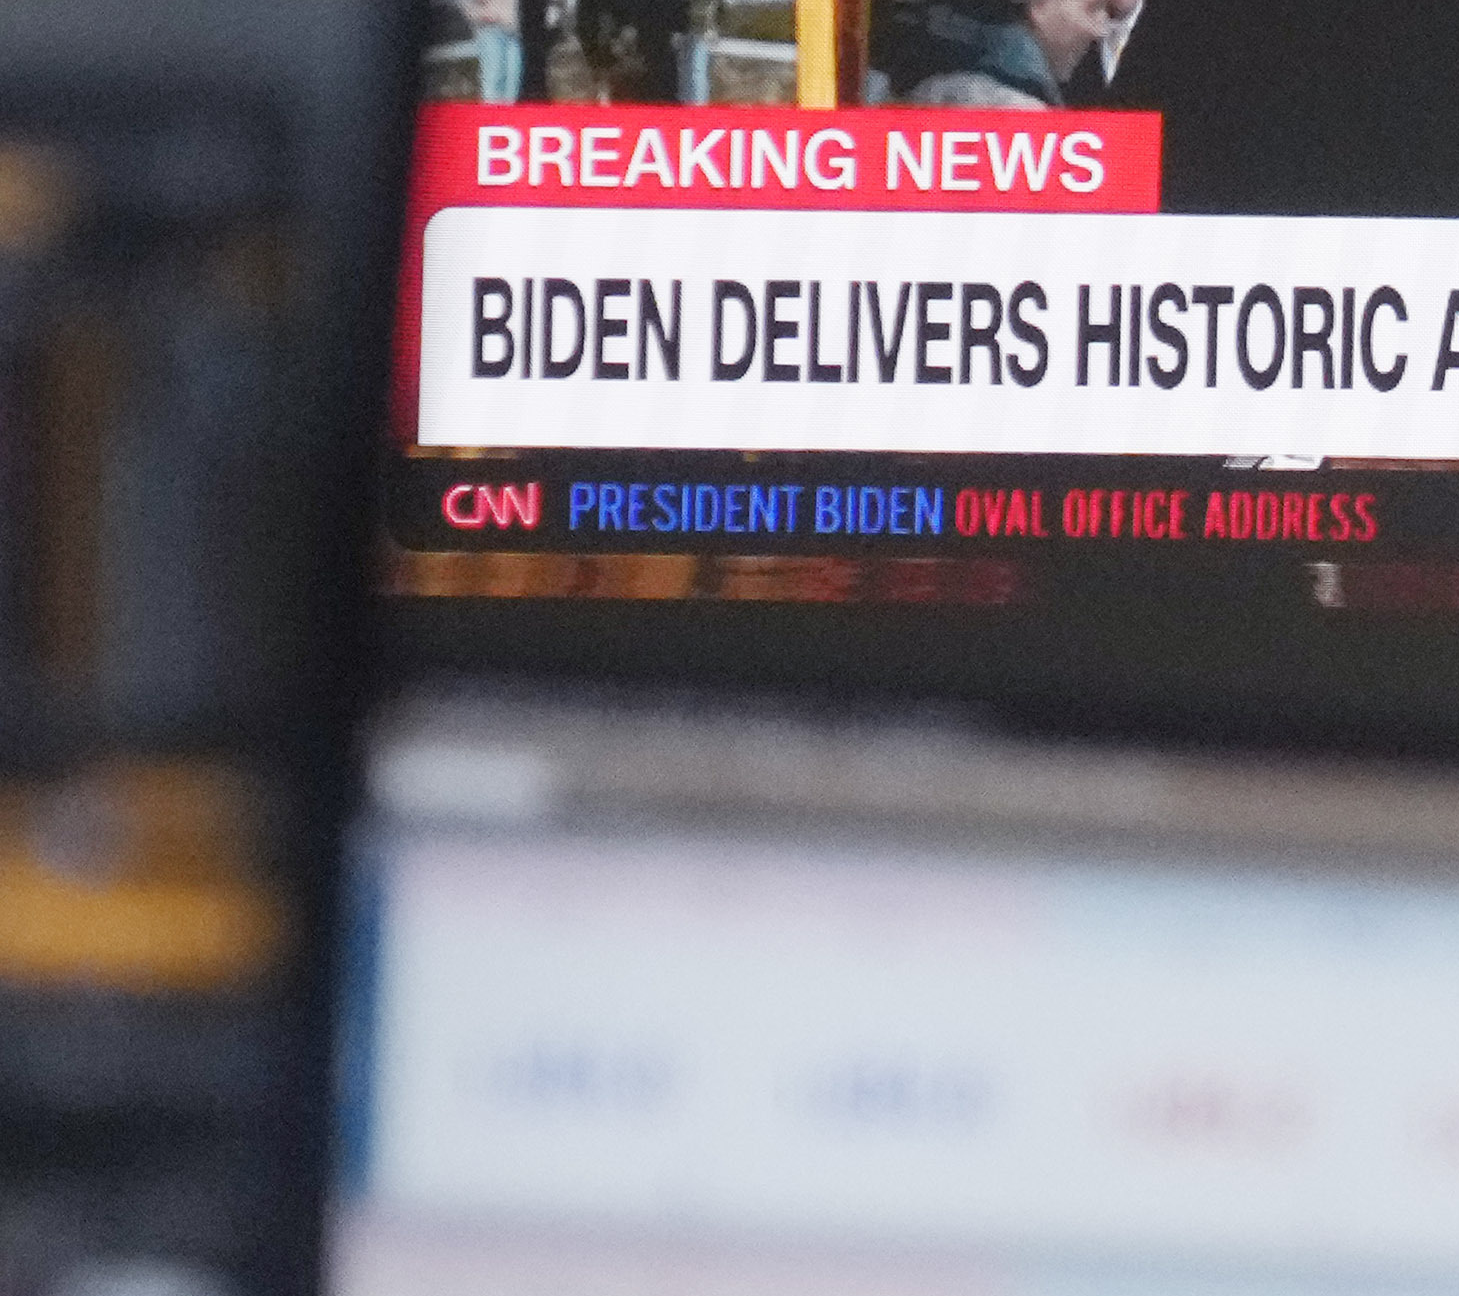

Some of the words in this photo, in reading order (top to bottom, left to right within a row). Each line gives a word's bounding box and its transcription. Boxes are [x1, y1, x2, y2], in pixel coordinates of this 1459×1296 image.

[476, 125, 858, 190] BREAKING
[885, 130, 1106, 194] NEWS
[472, 276, 683, 382] BIDEN
[711, 278, 1050, 389] DELIVERS
[1075, 282, 1409, 393] HISTORIC
[441, 483, 543, 531] CNN
[568, 481, 804, 534] PRESIDENT
[813, 484, 945, 536] BIDEN
[953, 487, 1049, 538] OVAL
[1061, 488, 1190, 541] OFFICE
[1203, 490, 1379, 543] ADDRESS
